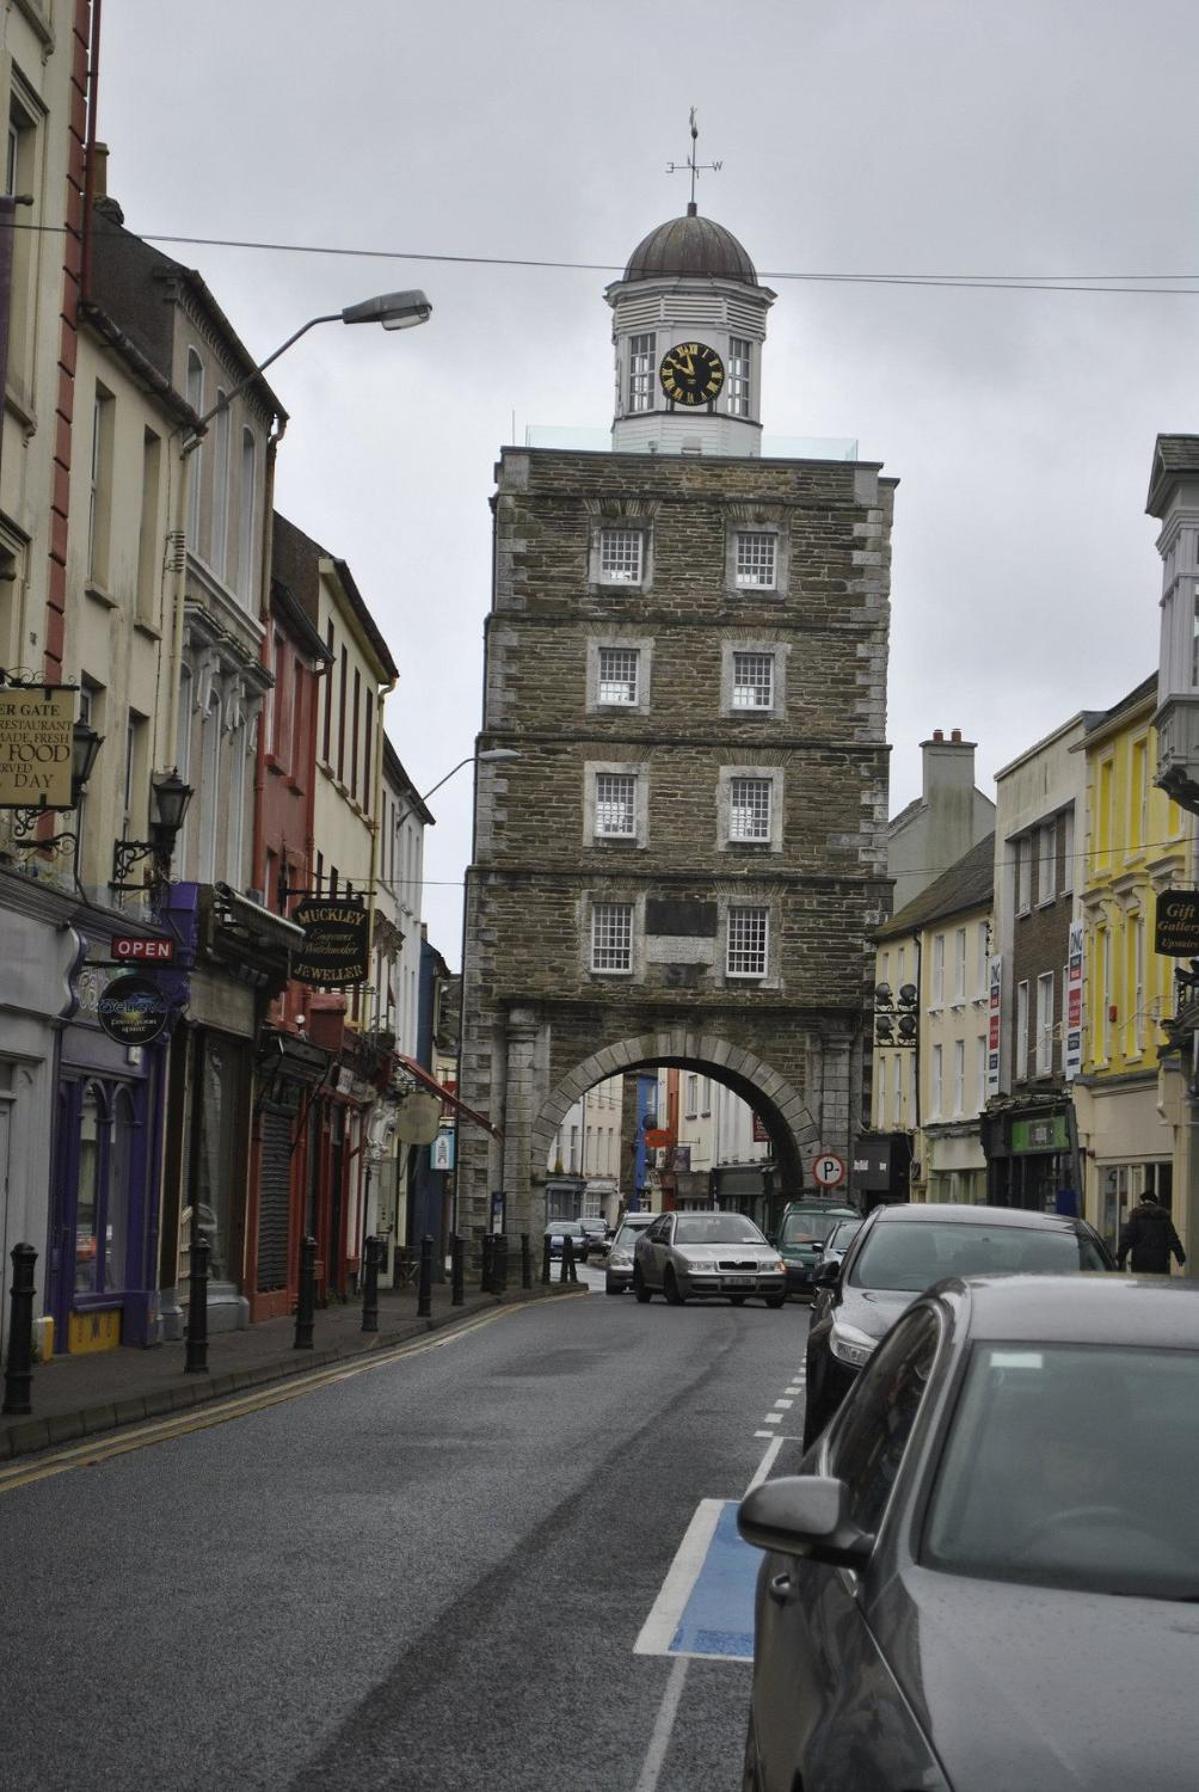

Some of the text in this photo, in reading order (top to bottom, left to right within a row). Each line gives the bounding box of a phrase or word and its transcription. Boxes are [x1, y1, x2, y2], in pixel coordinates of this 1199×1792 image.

[21, 704, 60, 716] GATE
[0, 720, 71, 731] RESTAURANT
[34, 733, 70, 743] FRESH
[9, 743, 71, 763] FOOD
[14, 773, 54, 788] DAY
[298, 907, 365, 926] MUCKLEY
[1167, 903, 1196, 921] Gift
[117, 940, 170, 957] OPEN
[294, 963, 364, 980] JEWELLER
